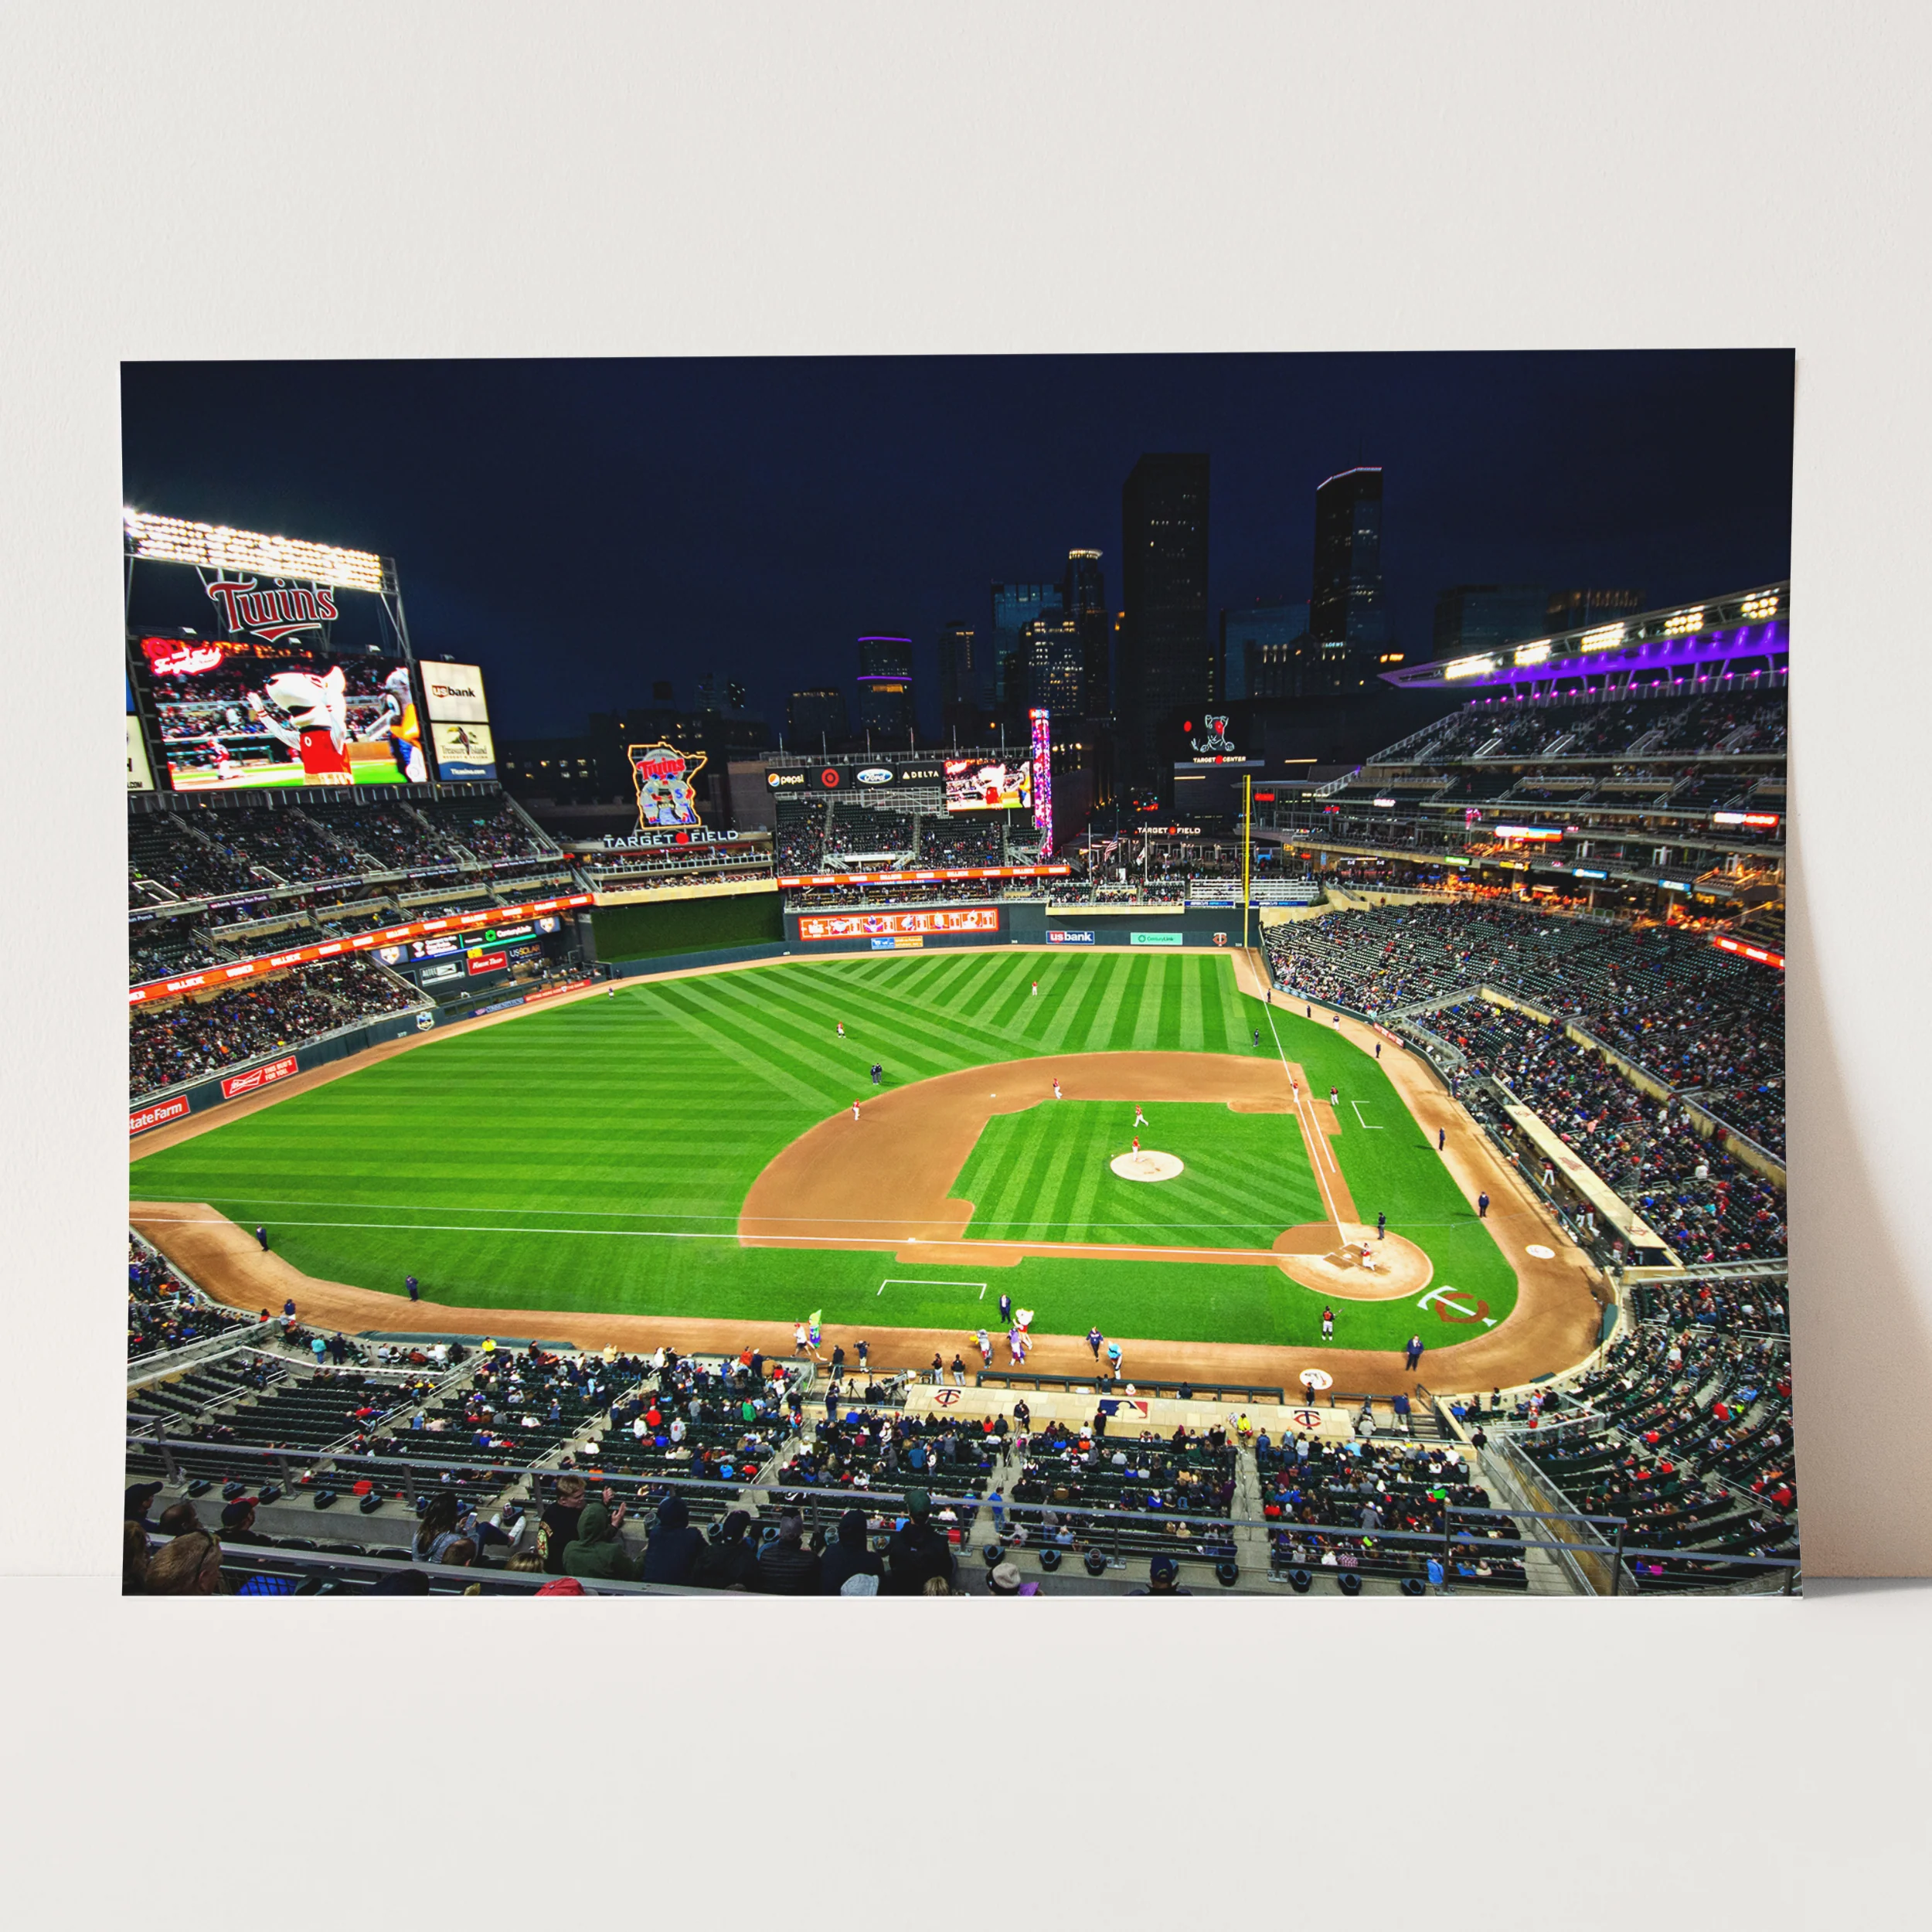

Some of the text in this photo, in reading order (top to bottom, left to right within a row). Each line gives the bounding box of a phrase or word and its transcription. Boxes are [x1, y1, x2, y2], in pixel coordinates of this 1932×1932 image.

[207, 577, 338, 635] Twins
[431, 685, 476, 698] usbank
[636, 757, 686, 782] Twins
[781, 774, 804, 785] pepsi
[863, 772, 886, 781] Ford
[604, 830, 739, 848] TARGET FIELD
[1050, 931, 1093, 942] usbank
[264, 1066, 277, 1074] THIS
[265, 1072, 277, 1081] FOR
